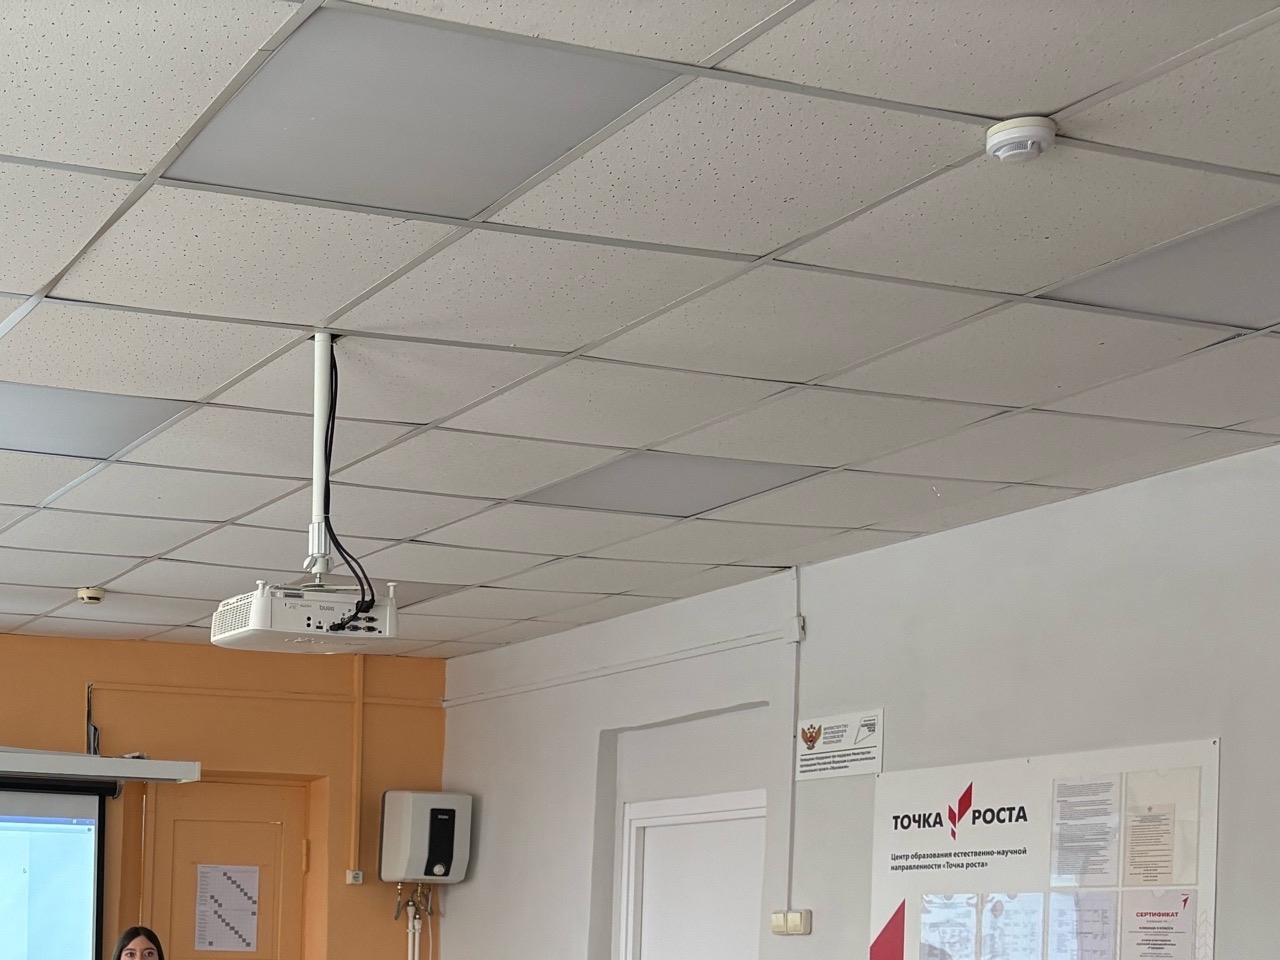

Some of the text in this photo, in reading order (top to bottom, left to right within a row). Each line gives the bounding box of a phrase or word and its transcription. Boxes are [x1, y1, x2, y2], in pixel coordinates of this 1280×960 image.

[892, 806, 1028, 831] ТОЧКА РОСТА
[890, 847, 1027, 861] Центр образования естественно-научной
[890, 862, 942, 872] направленности
